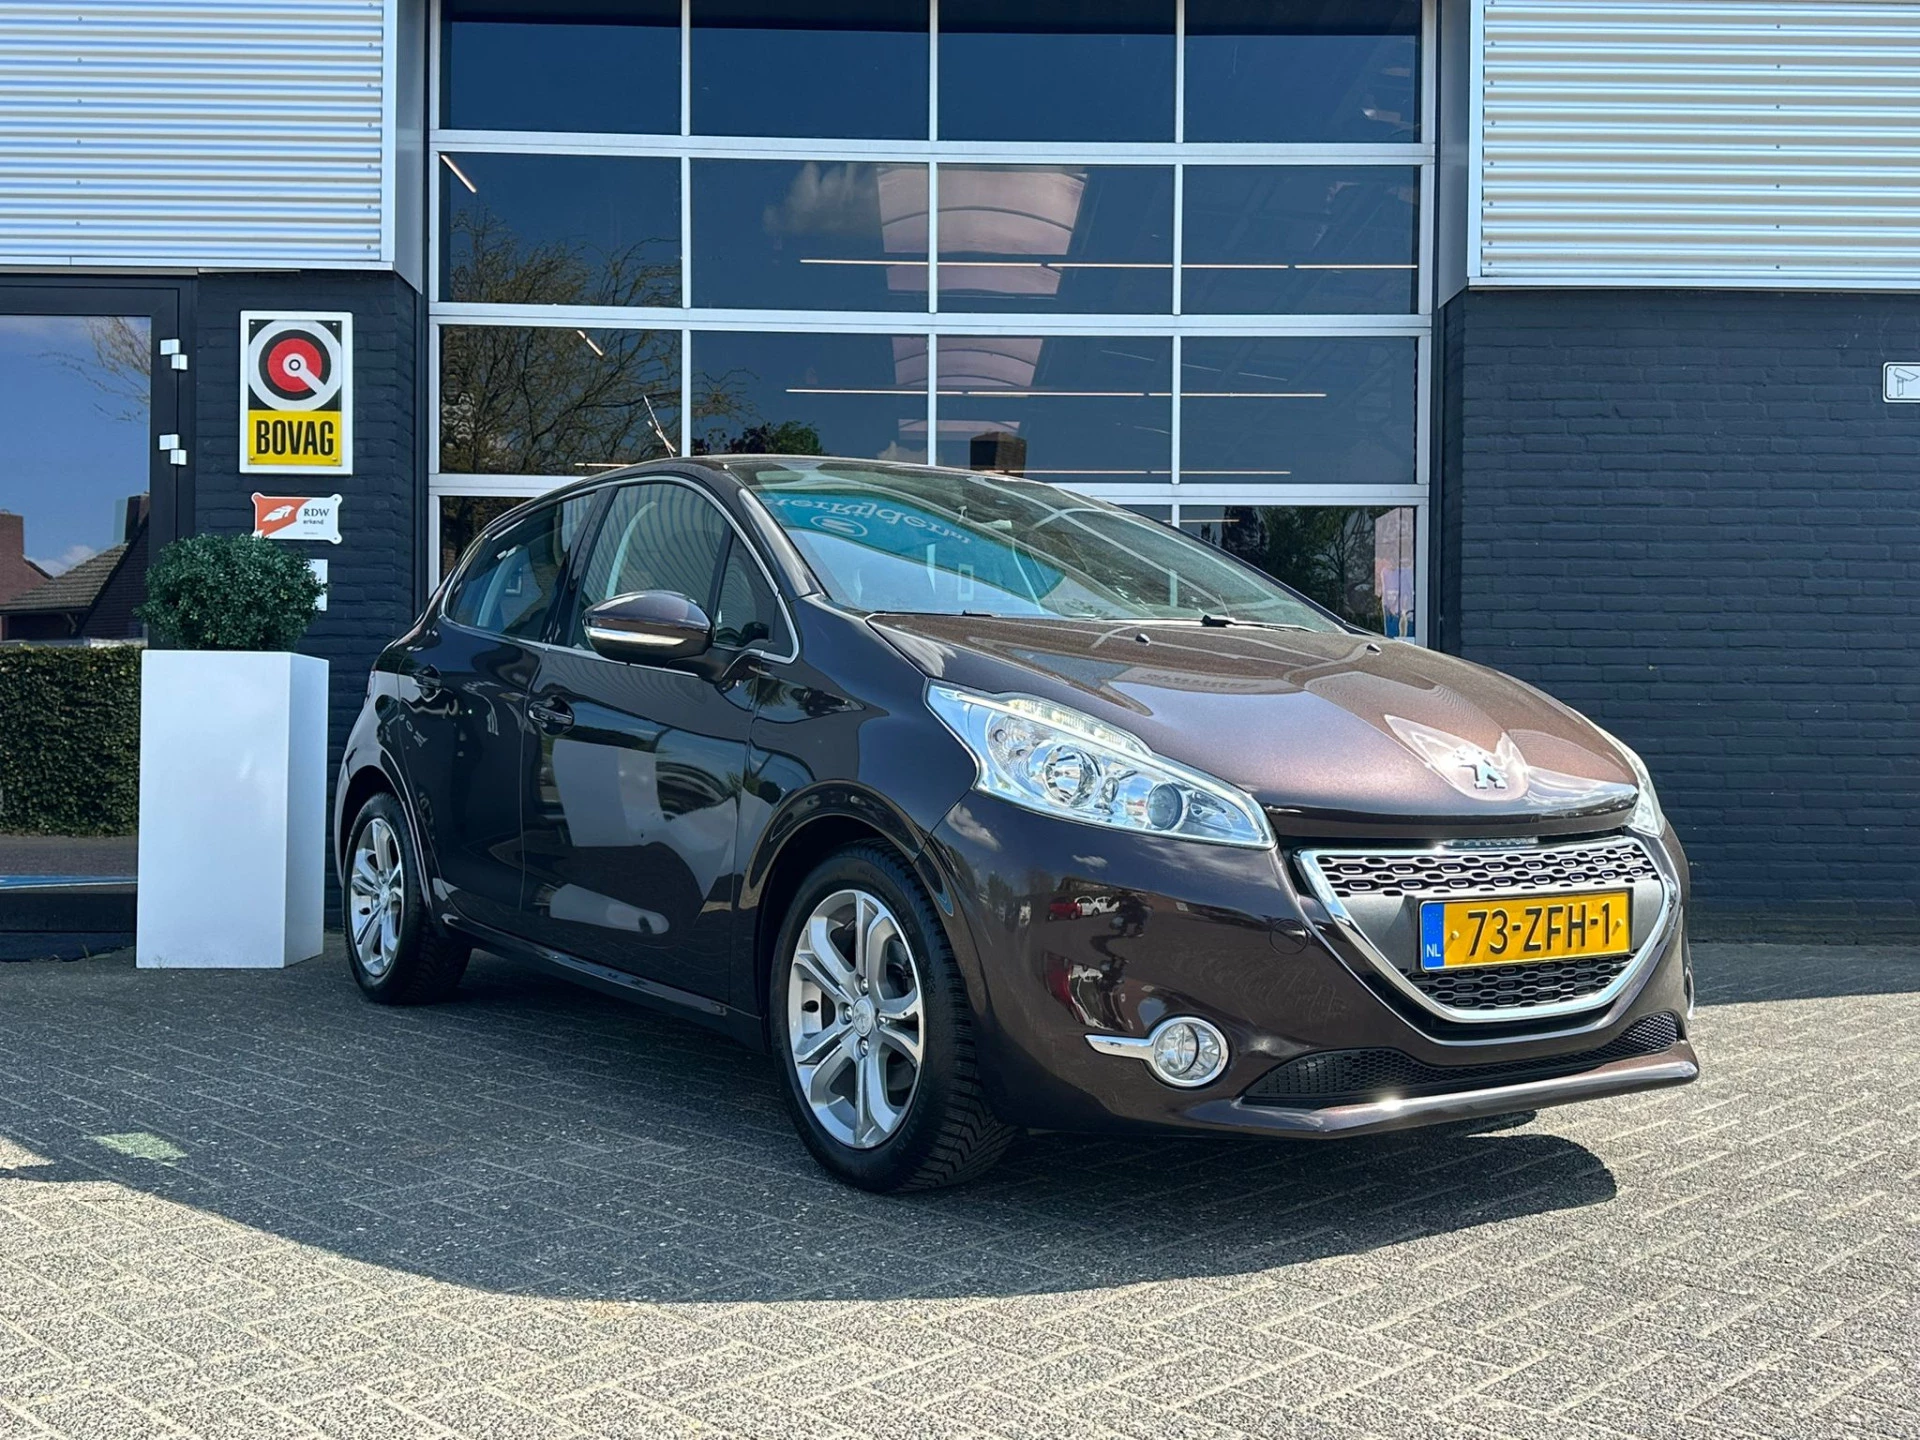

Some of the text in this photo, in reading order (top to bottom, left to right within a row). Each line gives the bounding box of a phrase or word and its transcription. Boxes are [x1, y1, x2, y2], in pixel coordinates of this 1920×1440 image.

[256, 420, 334, 455] BOVAG
[304, 508, 329, 516] RDW
[1467, 902, 1611, 957] 73-ZFH-1
[1427, 944, 1441, 958] NL
